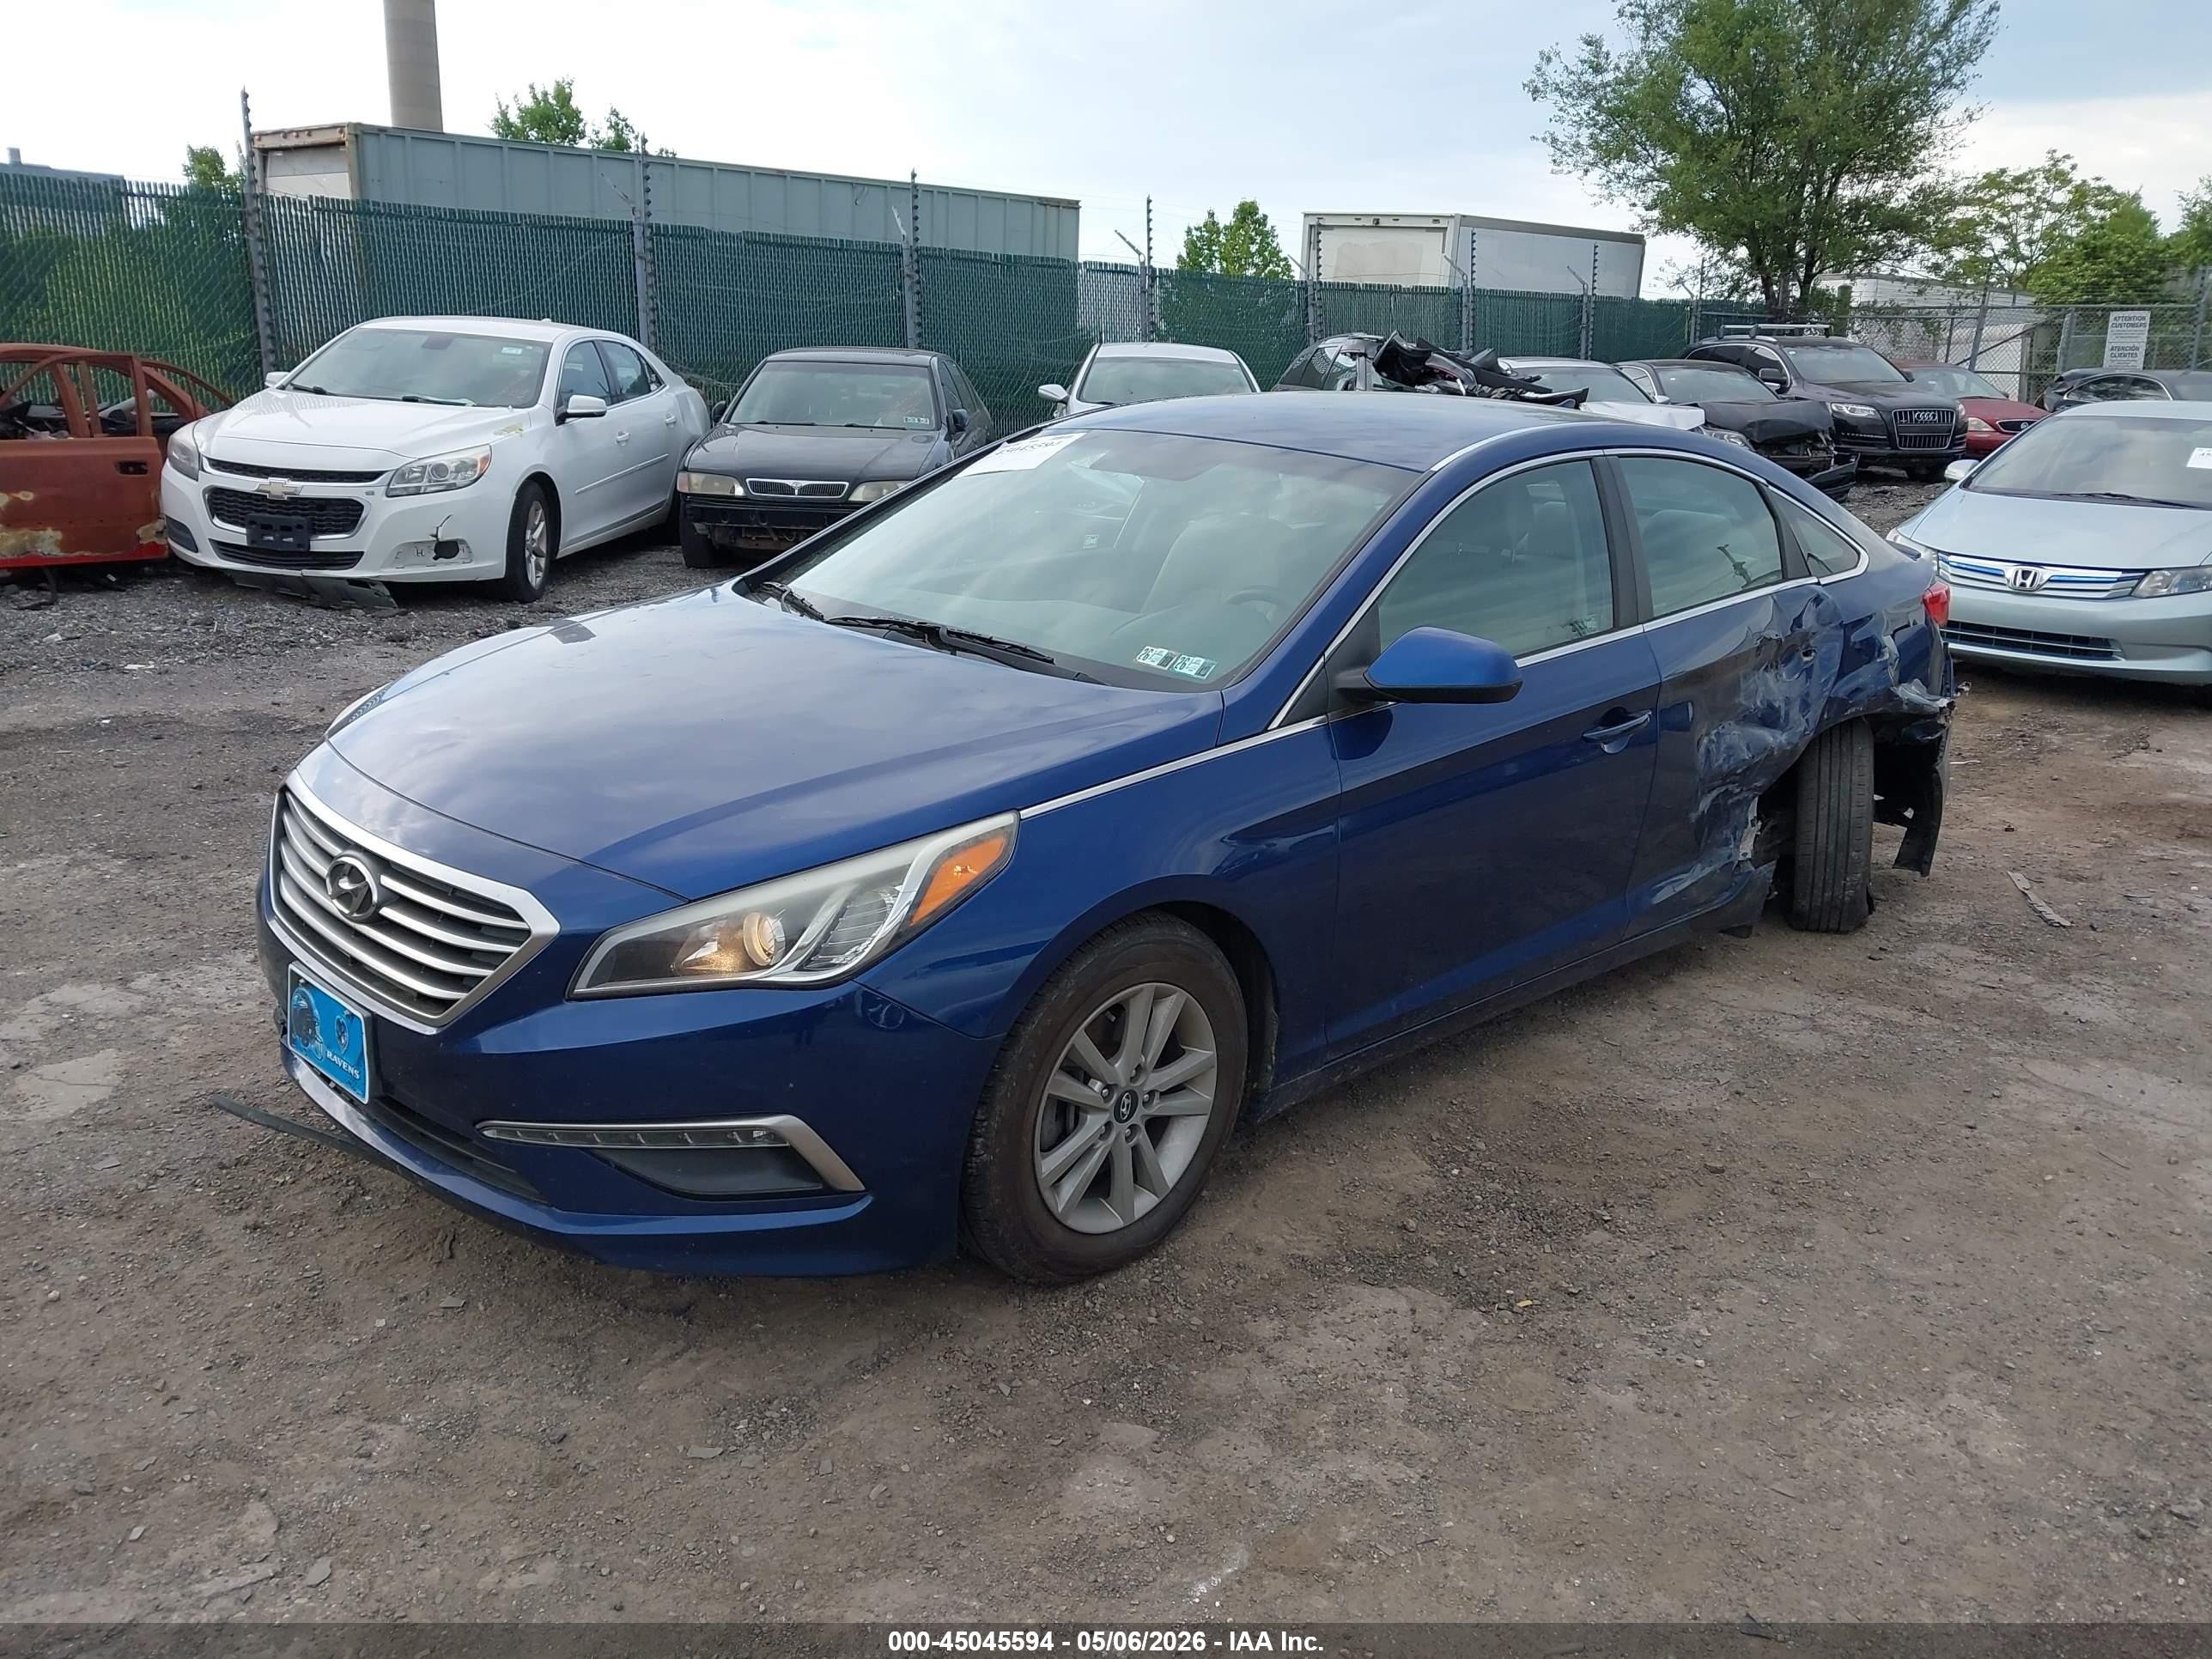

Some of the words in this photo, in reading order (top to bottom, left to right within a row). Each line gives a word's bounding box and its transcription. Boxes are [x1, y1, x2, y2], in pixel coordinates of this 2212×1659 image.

[1139, 647, 1153, 661] 26
[1176, 658, 1190, 670] 26
[326, 1049, 360, 1080] RAVENS
